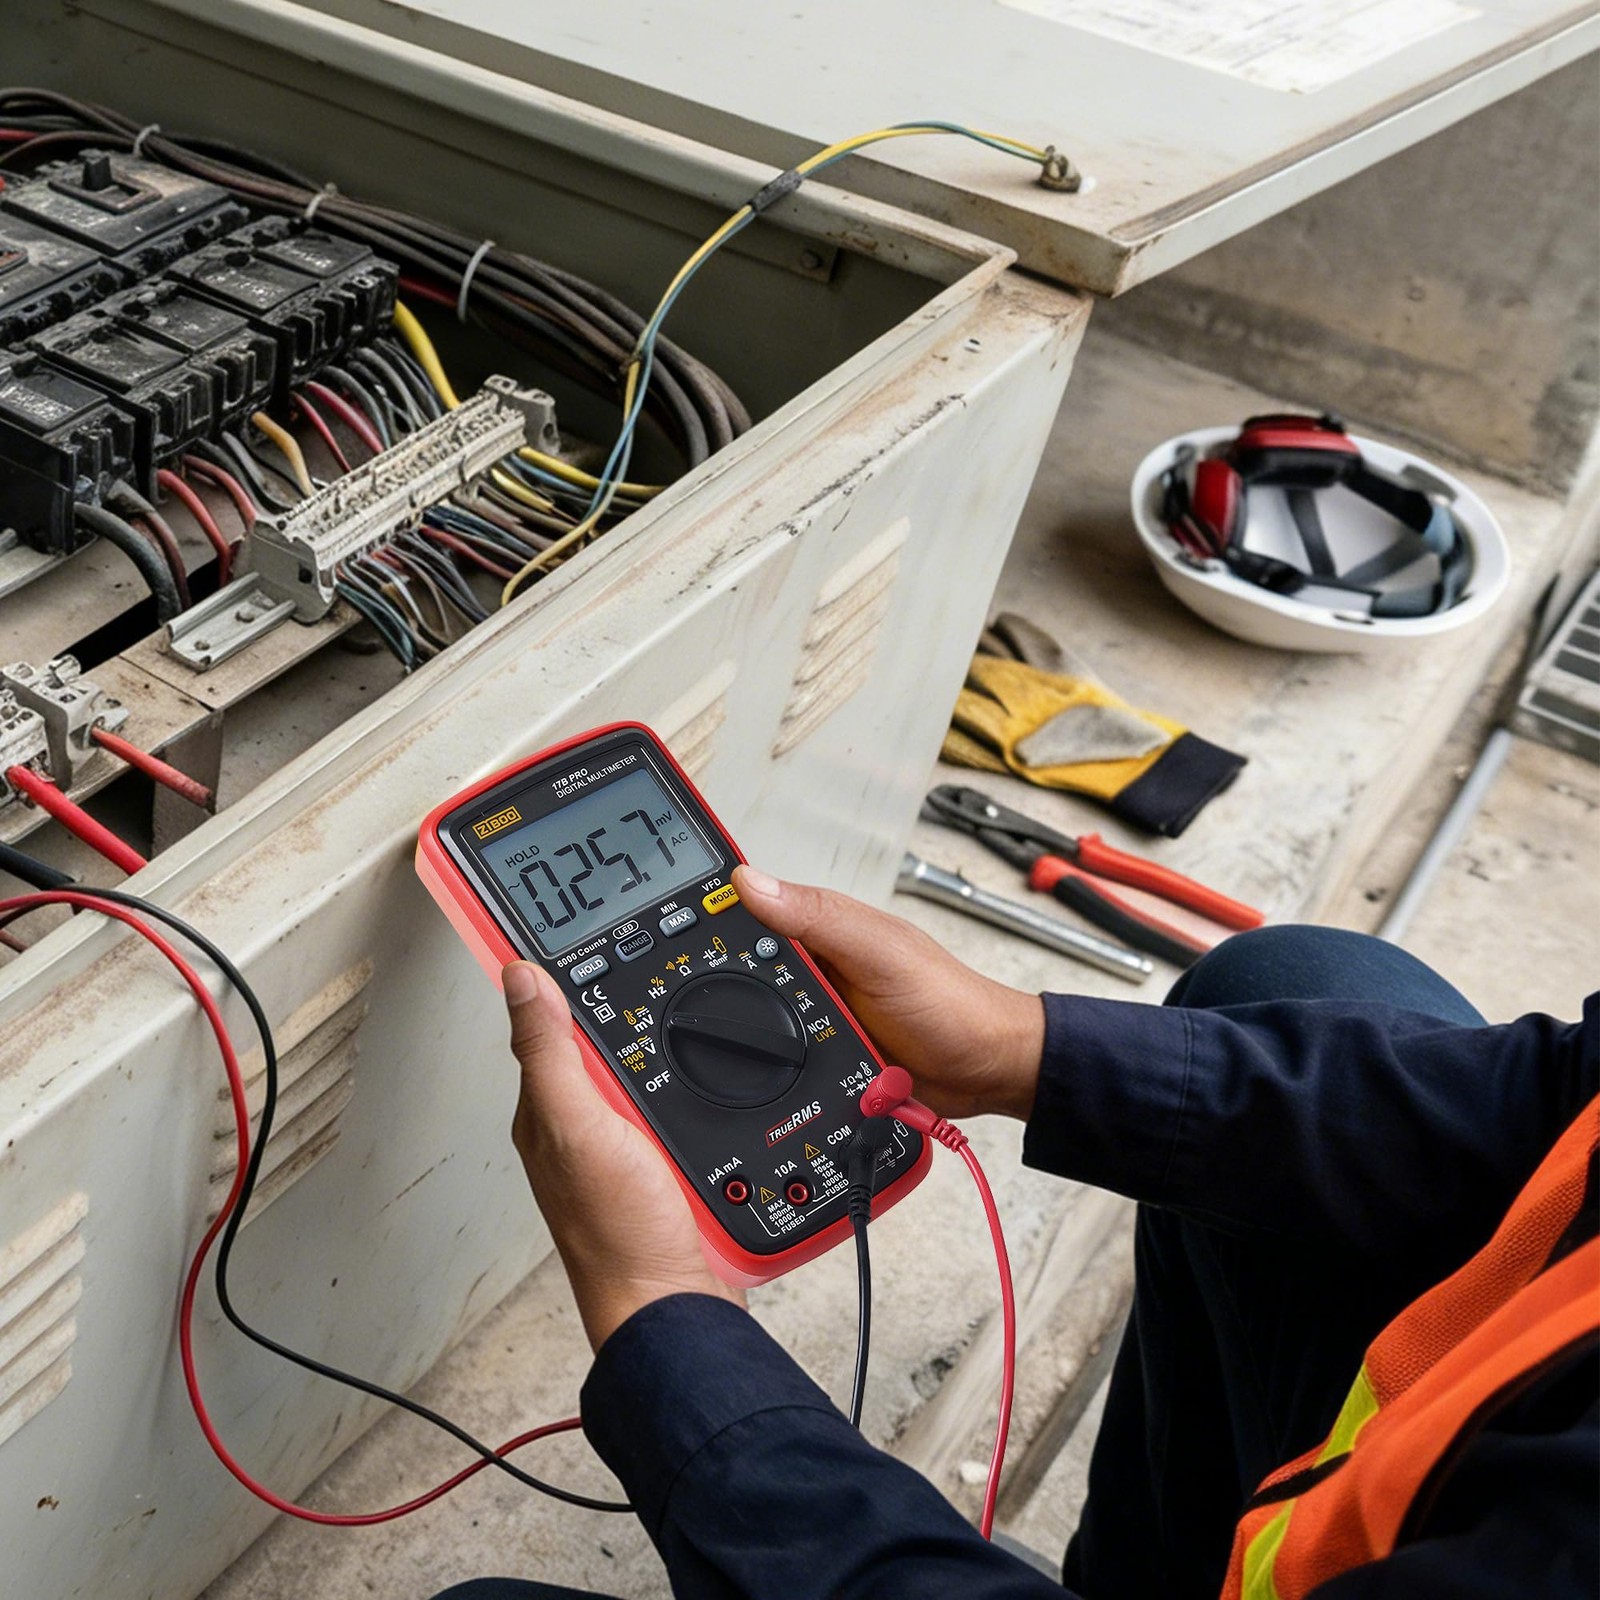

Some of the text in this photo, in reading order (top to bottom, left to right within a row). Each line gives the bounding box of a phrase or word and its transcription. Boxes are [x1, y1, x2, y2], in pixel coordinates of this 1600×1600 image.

[552, 768, 588, 790] 17B PRO
[555, 755, 637, 799] DIGITAL MULTIMETER
[476, 811, 517, 836] ZIBOO
[655, 811, 674, 828] mV
[671, 832, 689, 847] AC
[505, 844, 540, 868] HOLD
[701, 877, 722, 892] VFD
[709, 888, 736, 906] MODE
[660, 901, 678, 914] MIN
[668, 912, 691, 928] MAX
[618, 923, 634, 936] LED
[621, 934, 650, 953] RANGE
[557, 937, 608, 968] 6000 Counts
[577, 960, 604, 977] HOLD
[708, 955, 729, 968] 60mF
[747, 959, 758, 970] A
[775, 972, 794, 987] mA
[647, 985, 667, 1000] Hz
[633, 1013, 655, 1033] mV
[807, 1015, 832, 1035] NCV
[814, 1027, 837, 1043] LIVE
[616, 1042, 639, 1059] 1500
[645, 1042, 656, 1055] V
[621, 1050, 645, 1067] 1000
[631, 1061, 647, 1074] Hz
[645, 1070, 671, 1093] OFF
[826, 1124, 853, 1146] COM
[774, 1160, 798, 1178] 10A
[810, 1154, 828, 1168] MAX
[821, 1168, 837, 1179] 10A
[822, 1171, 844, 1188] 1000V
[825, 1178, 849, 1197] FUSED
[767, 1198, 785, 1213] MAX
[768, 1203, 794, 1222] 500mA
[774, 1210, 796, 1228] 1000V
[780, 1214, 806, 1234] FUSED
